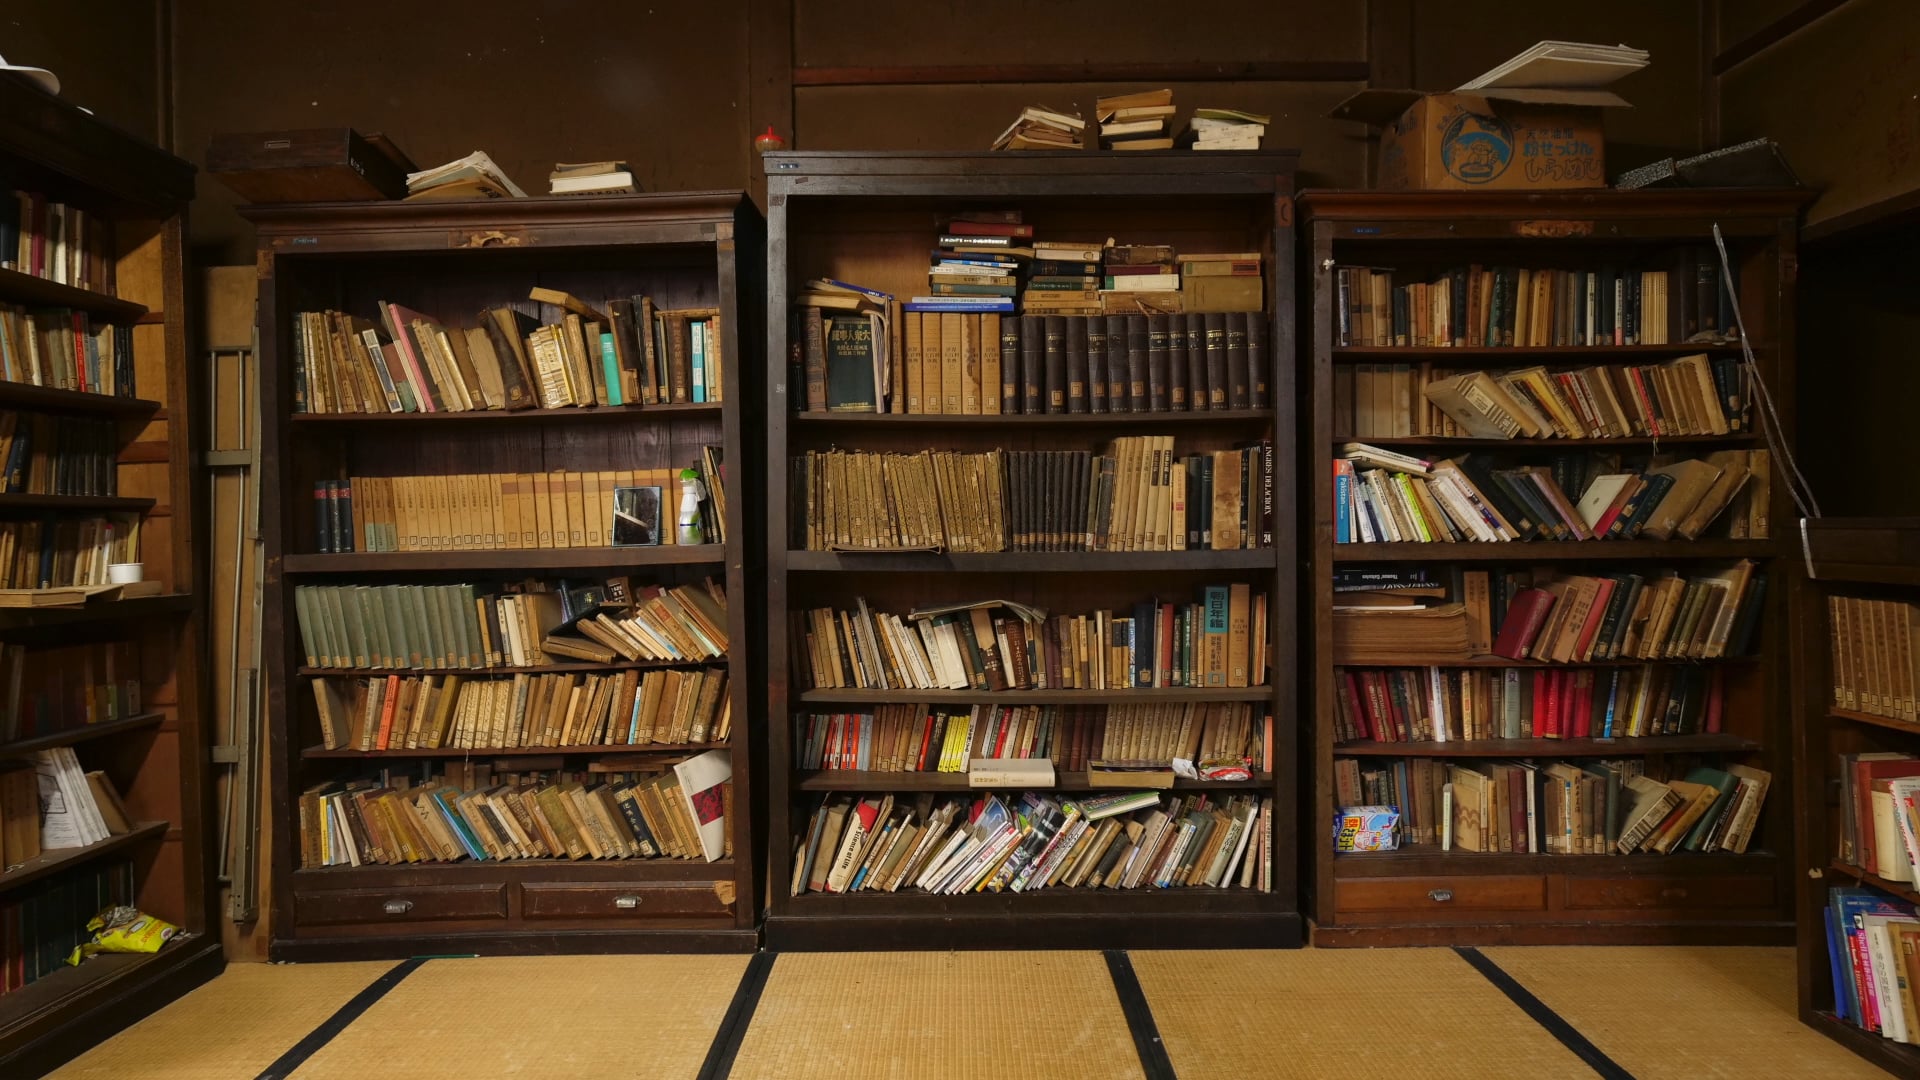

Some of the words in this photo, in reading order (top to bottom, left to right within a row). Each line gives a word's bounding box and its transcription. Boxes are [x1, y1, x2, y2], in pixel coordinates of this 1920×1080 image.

[1525, 141, 1594, 156] 粉せっけん
[1265, 446, 1273, 474] INGRES
[1264, 475, 1273, 515] DELACROIX
[1263, 533, 1272, 544] 24
[1210, 591, 1225, 629] 朝日年鑑
[1339, 817, 1358, 850] 熱さまシート
